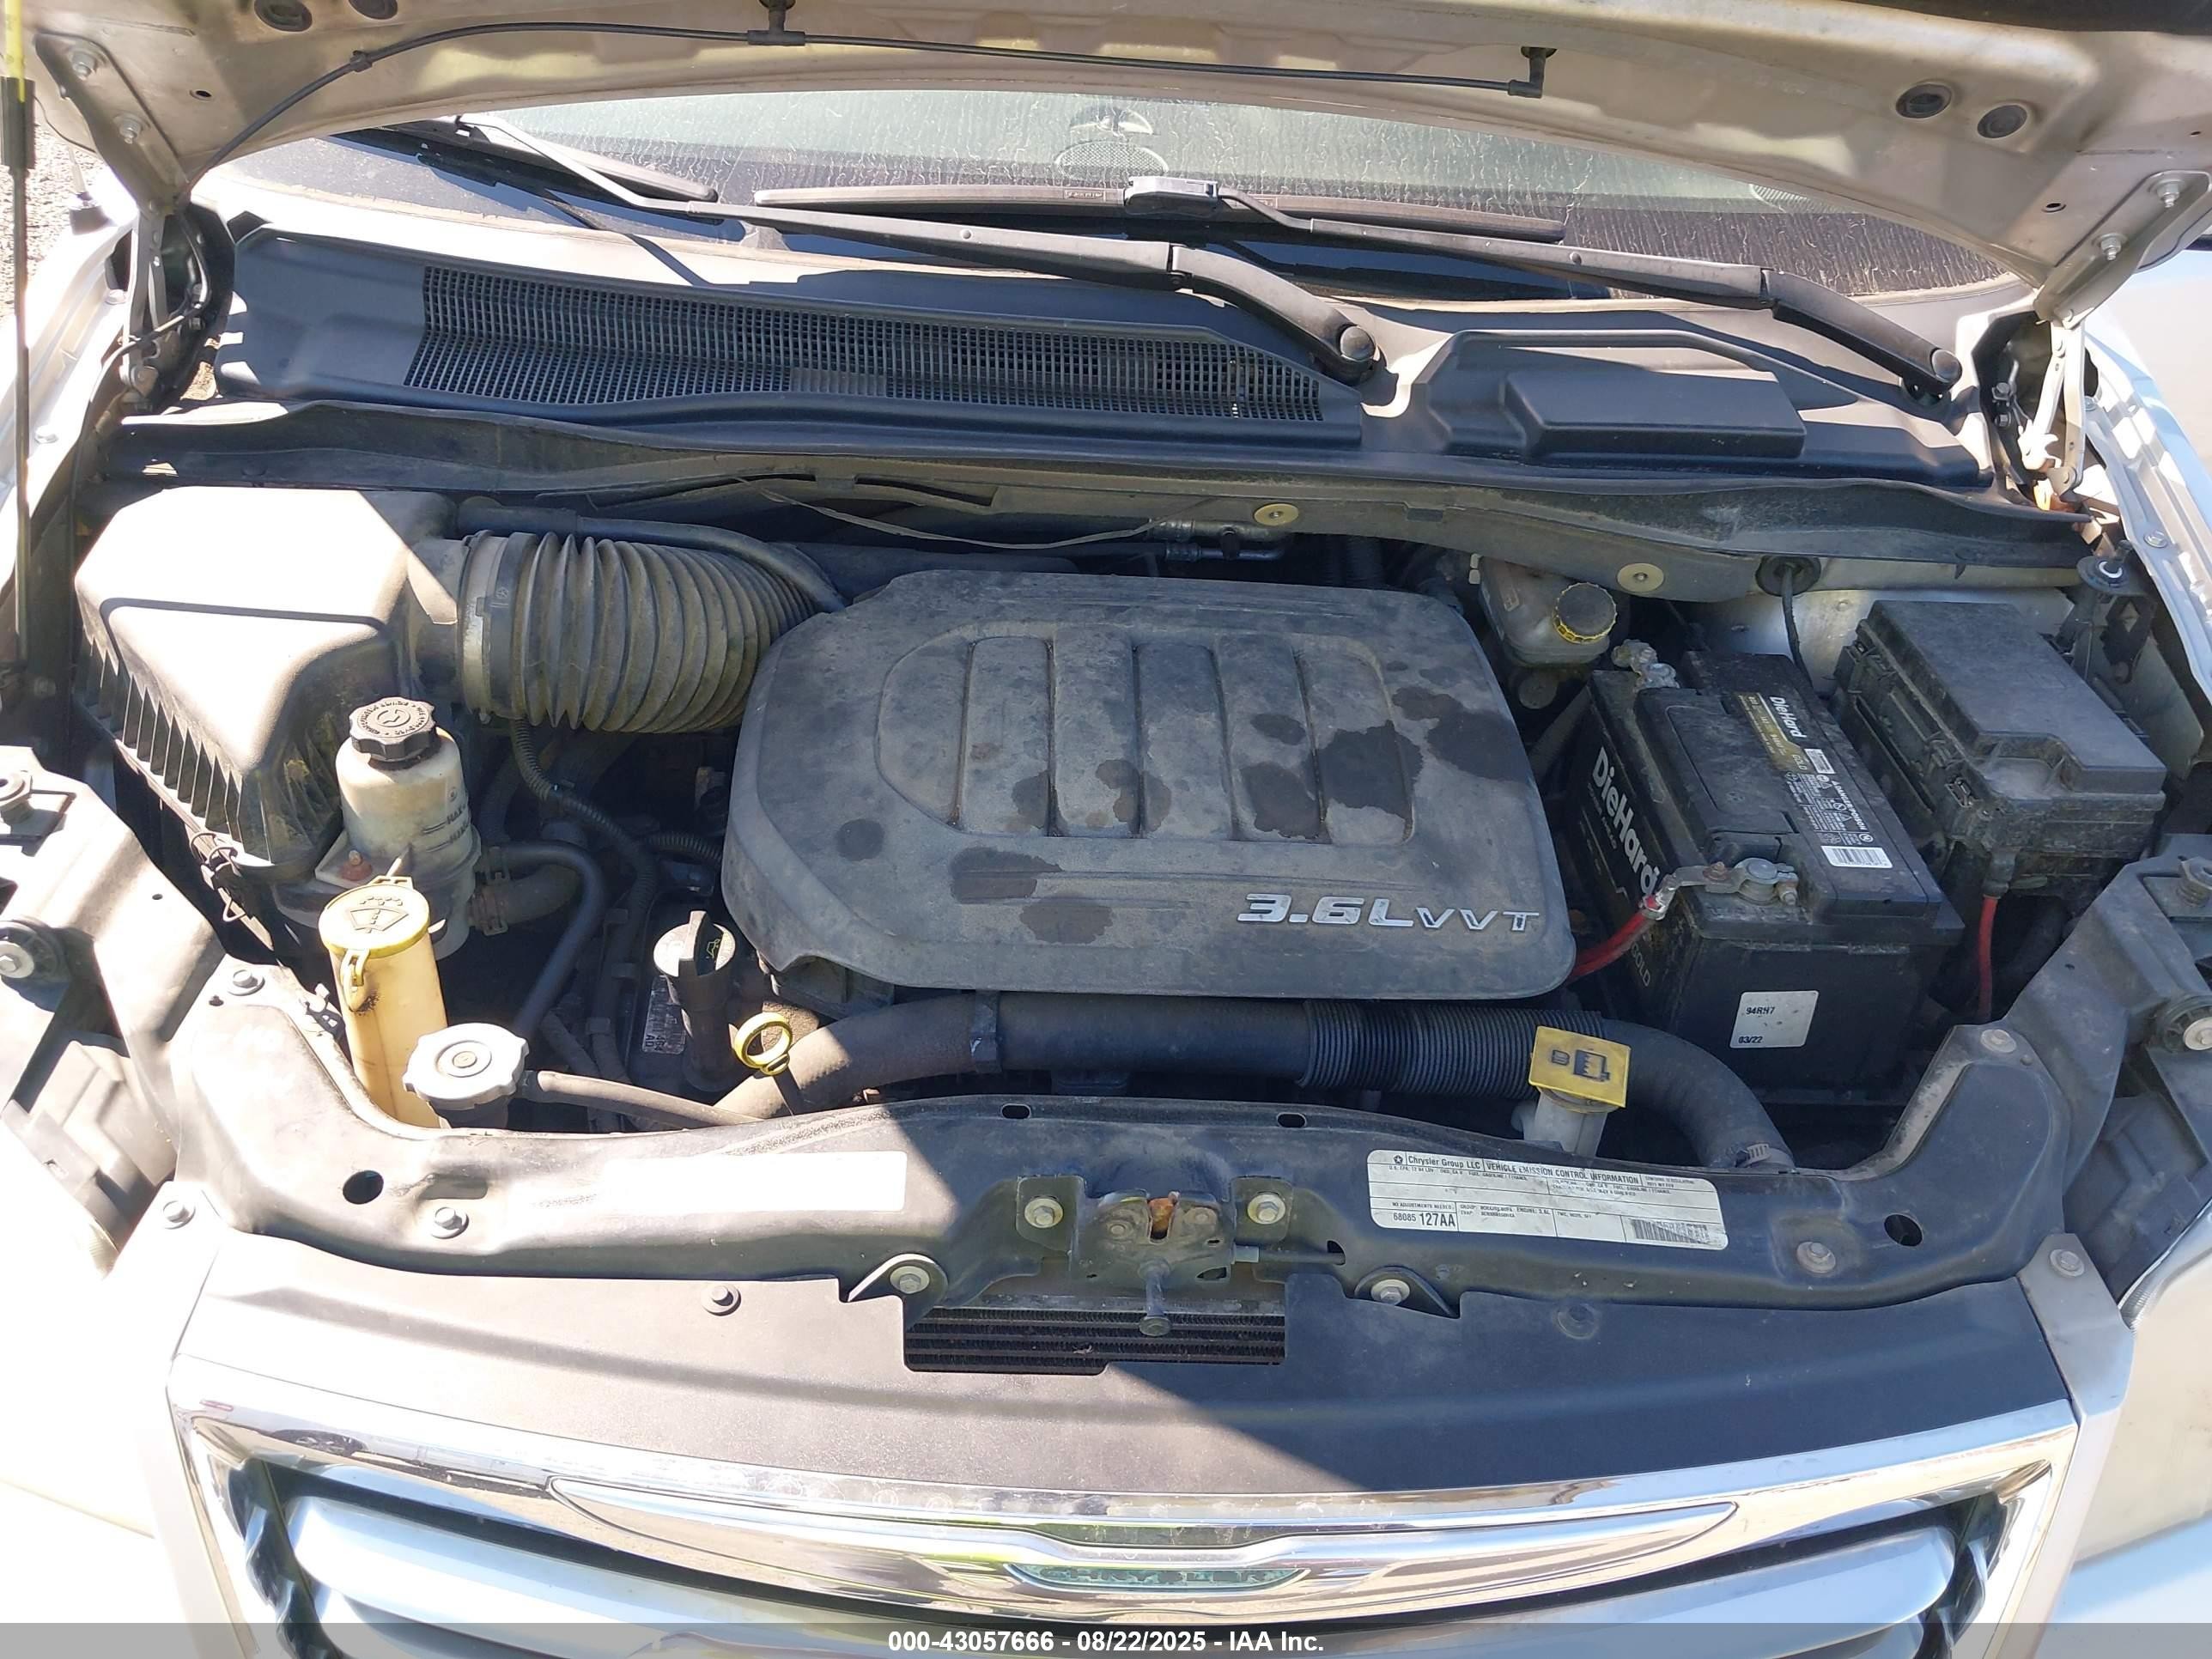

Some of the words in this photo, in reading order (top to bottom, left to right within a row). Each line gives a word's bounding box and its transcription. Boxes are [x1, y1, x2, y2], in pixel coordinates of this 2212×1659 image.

[1769, 696, 1807, 738] DieHard
[1592, 745, 1661, 896] DieHard
[1237, 893, 1413, 927] 3.6L
[1416, 907, 1540, 932] VVT
[1738, 1036, 1764, 1044] 03/22
[1408, 1155, 1439, 1166] Chrysler
[1442, 1158, 1464, 1169] Group
[1467, 1160, 1480, 1170] LLC
[1486, 1162, 1517, 1173] VEHICLE
[1519, 1166, 1553, 1176] EMISSION
[1555, 1170, 1588, 1180] CONTROL
[1590, 1172, 1639, 1184] INFORMATION
[1393, 1212, 1416, 1221] 68085
[1419, 1212, 1455, 1226] 127AA
